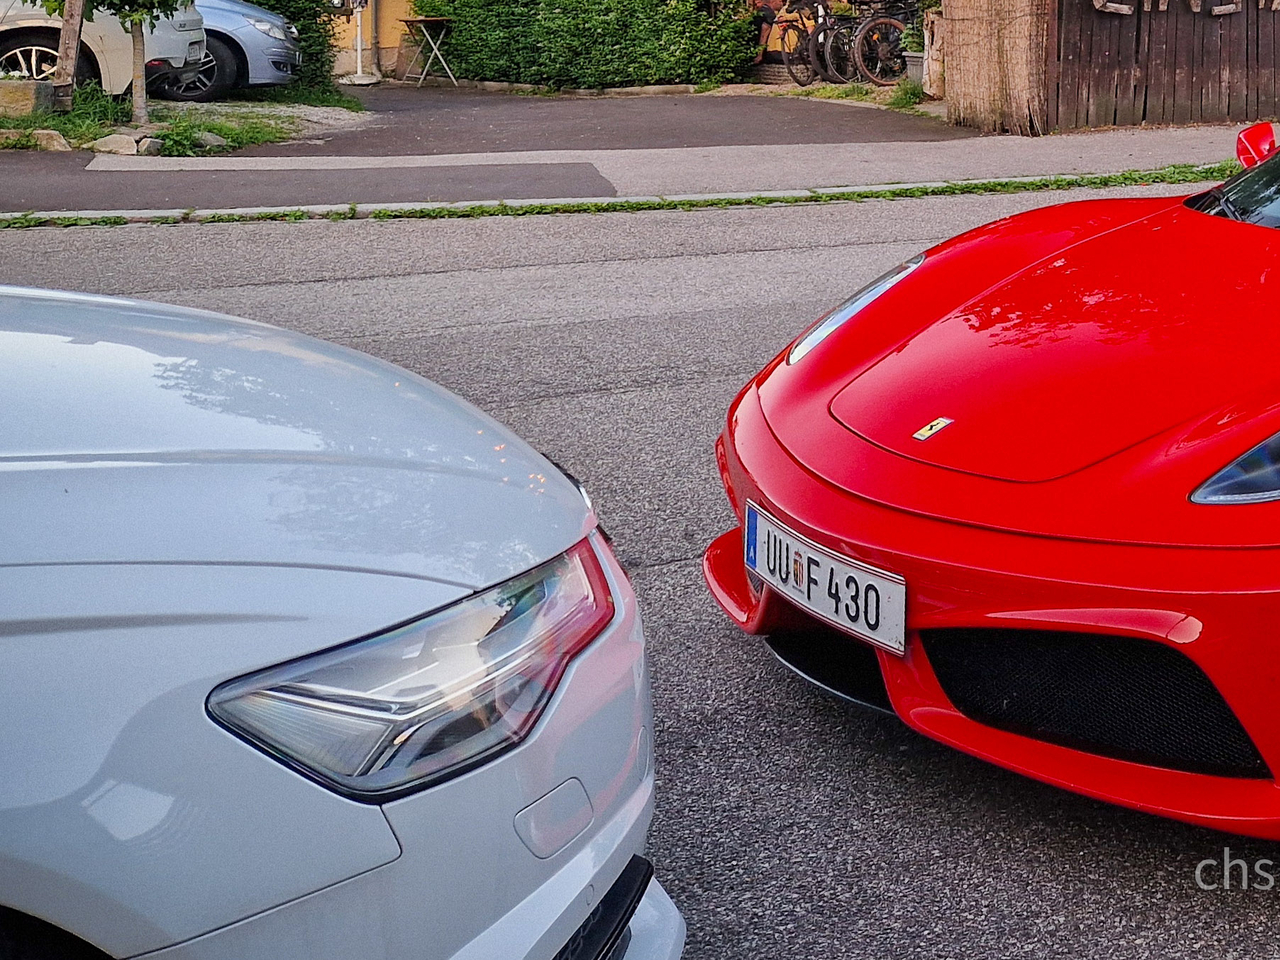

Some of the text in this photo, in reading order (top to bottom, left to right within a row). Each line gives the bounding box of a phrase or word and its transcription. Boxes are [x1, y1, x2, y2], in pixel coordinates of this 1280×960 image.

[766, 529, 881, 631] UU F 430
